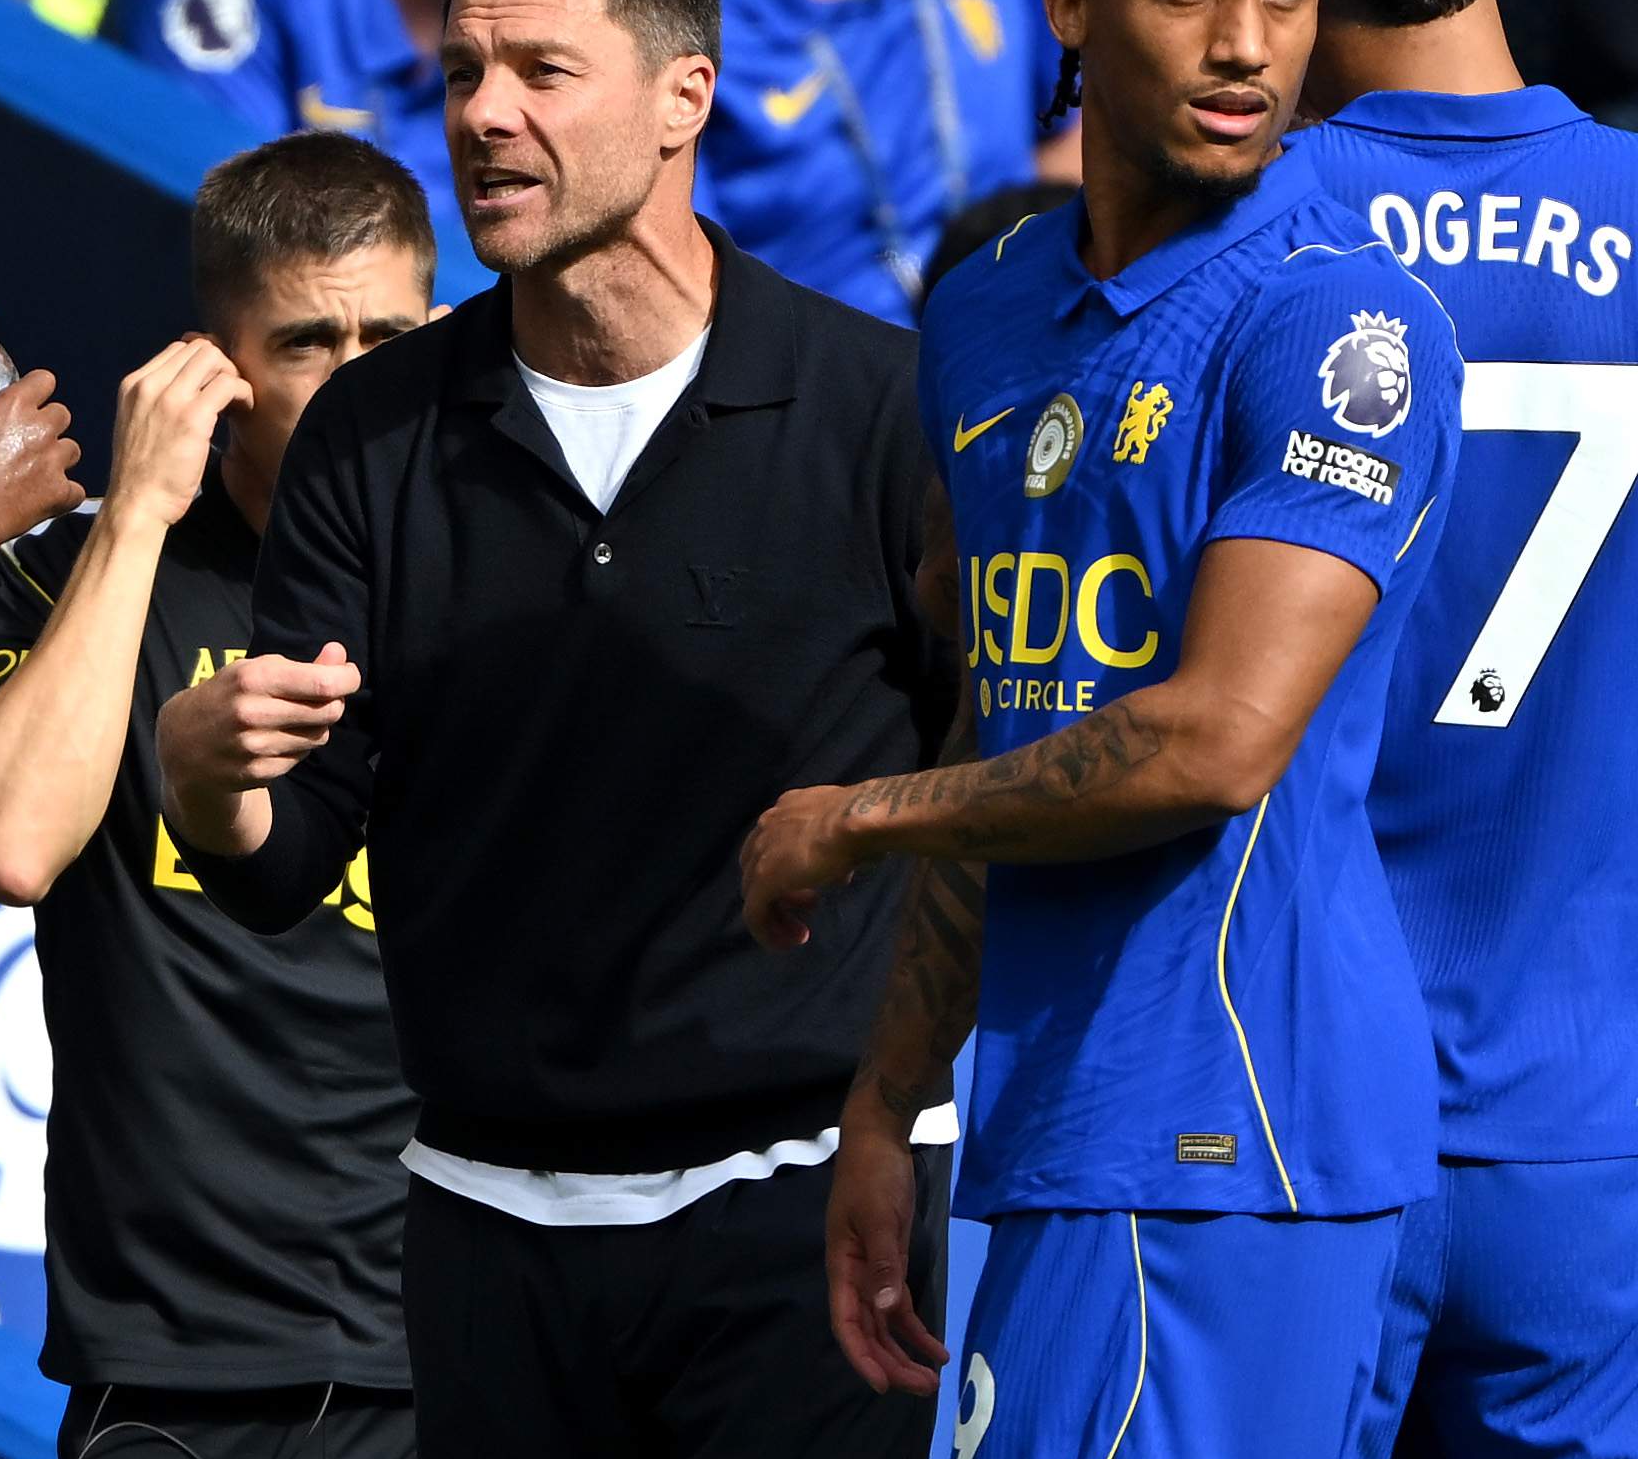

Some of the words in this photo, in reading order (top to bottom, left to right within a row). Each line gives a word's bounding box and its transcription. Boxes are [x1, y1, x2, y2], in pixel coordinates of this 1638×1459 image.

[1281, 451, 1320, 479] for
[1318, 464, 1393, 506] racism
[1286, 430, 1324, 460] No
[1326, 445, 1389, 483] room
[998, 677, 1096, 714] CIRCLE
